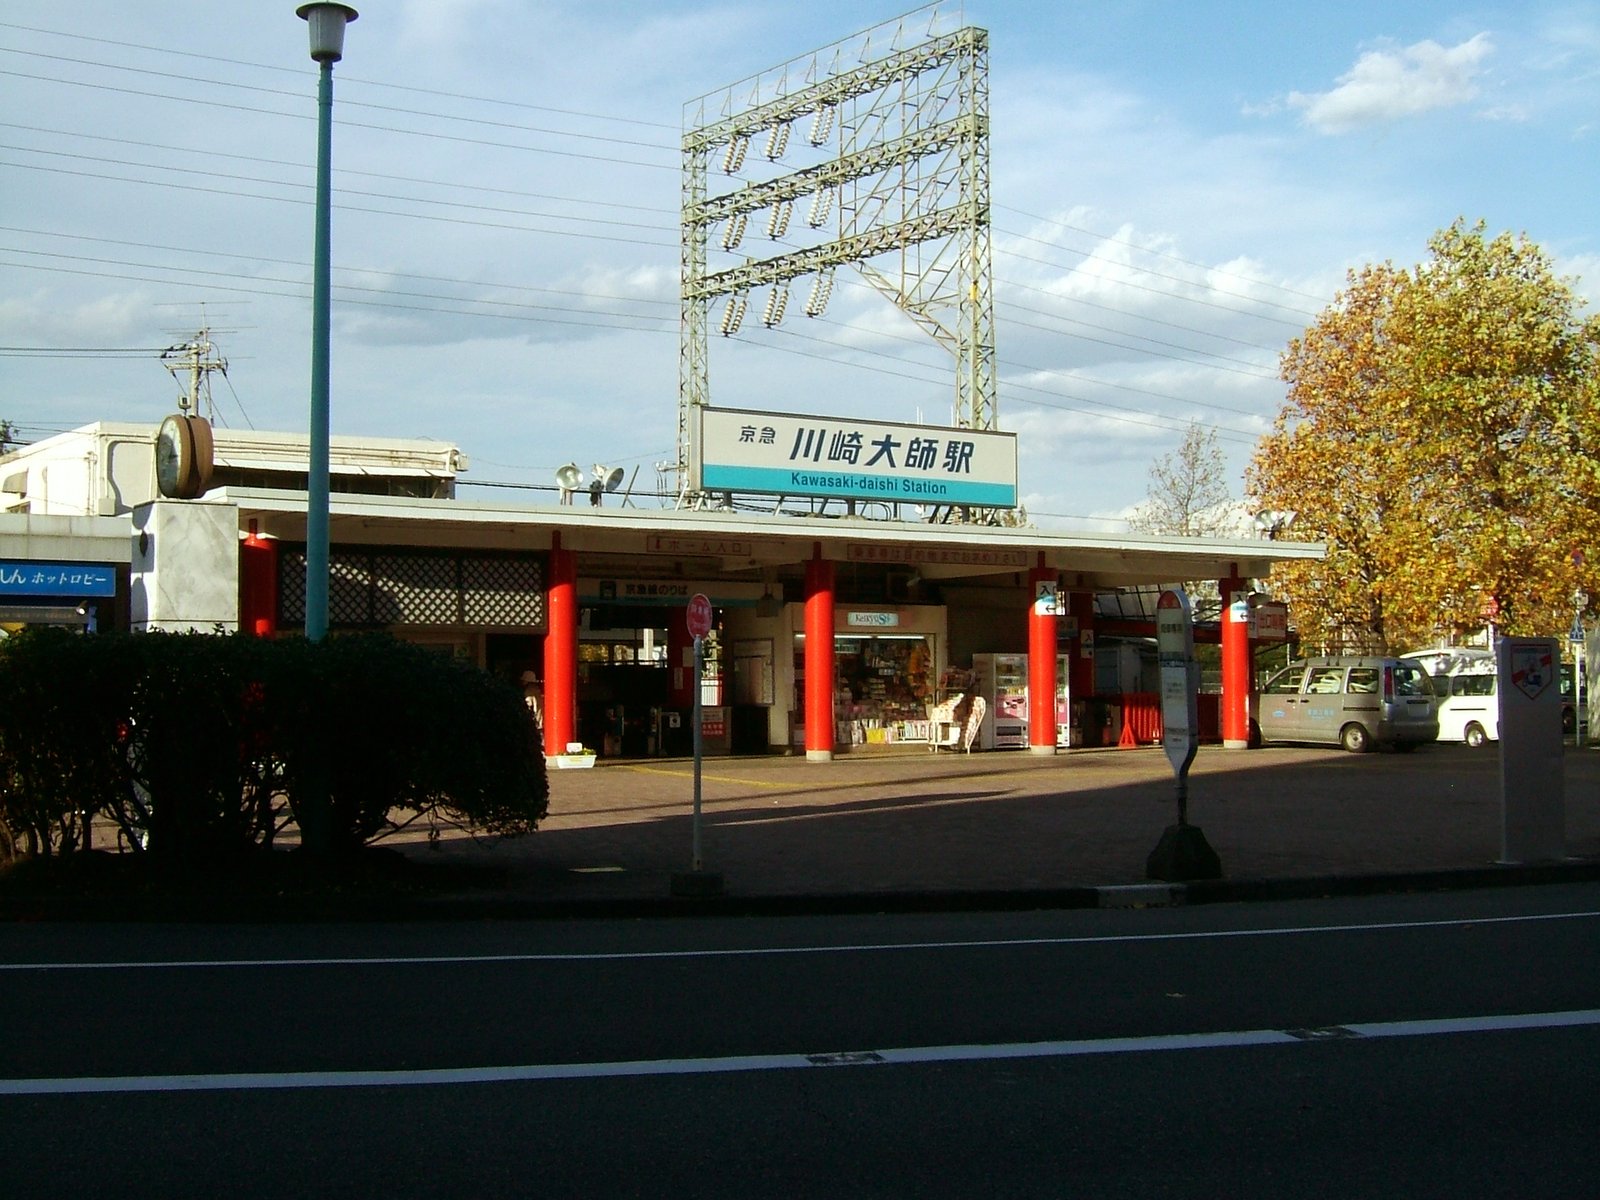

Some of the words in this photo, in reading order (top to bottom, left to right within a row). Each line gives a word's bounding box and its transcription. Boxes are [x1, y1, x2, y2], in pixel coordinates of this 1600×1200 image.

[738, 425, 777, 445] 京急
[789, 427, 975, 474] 川崎大師駅
[791, 471, 898, 491] Kawasaki-daishi
[902, 479, 947, 495] Station
[32, 572, 107, 585] ホットロビー
